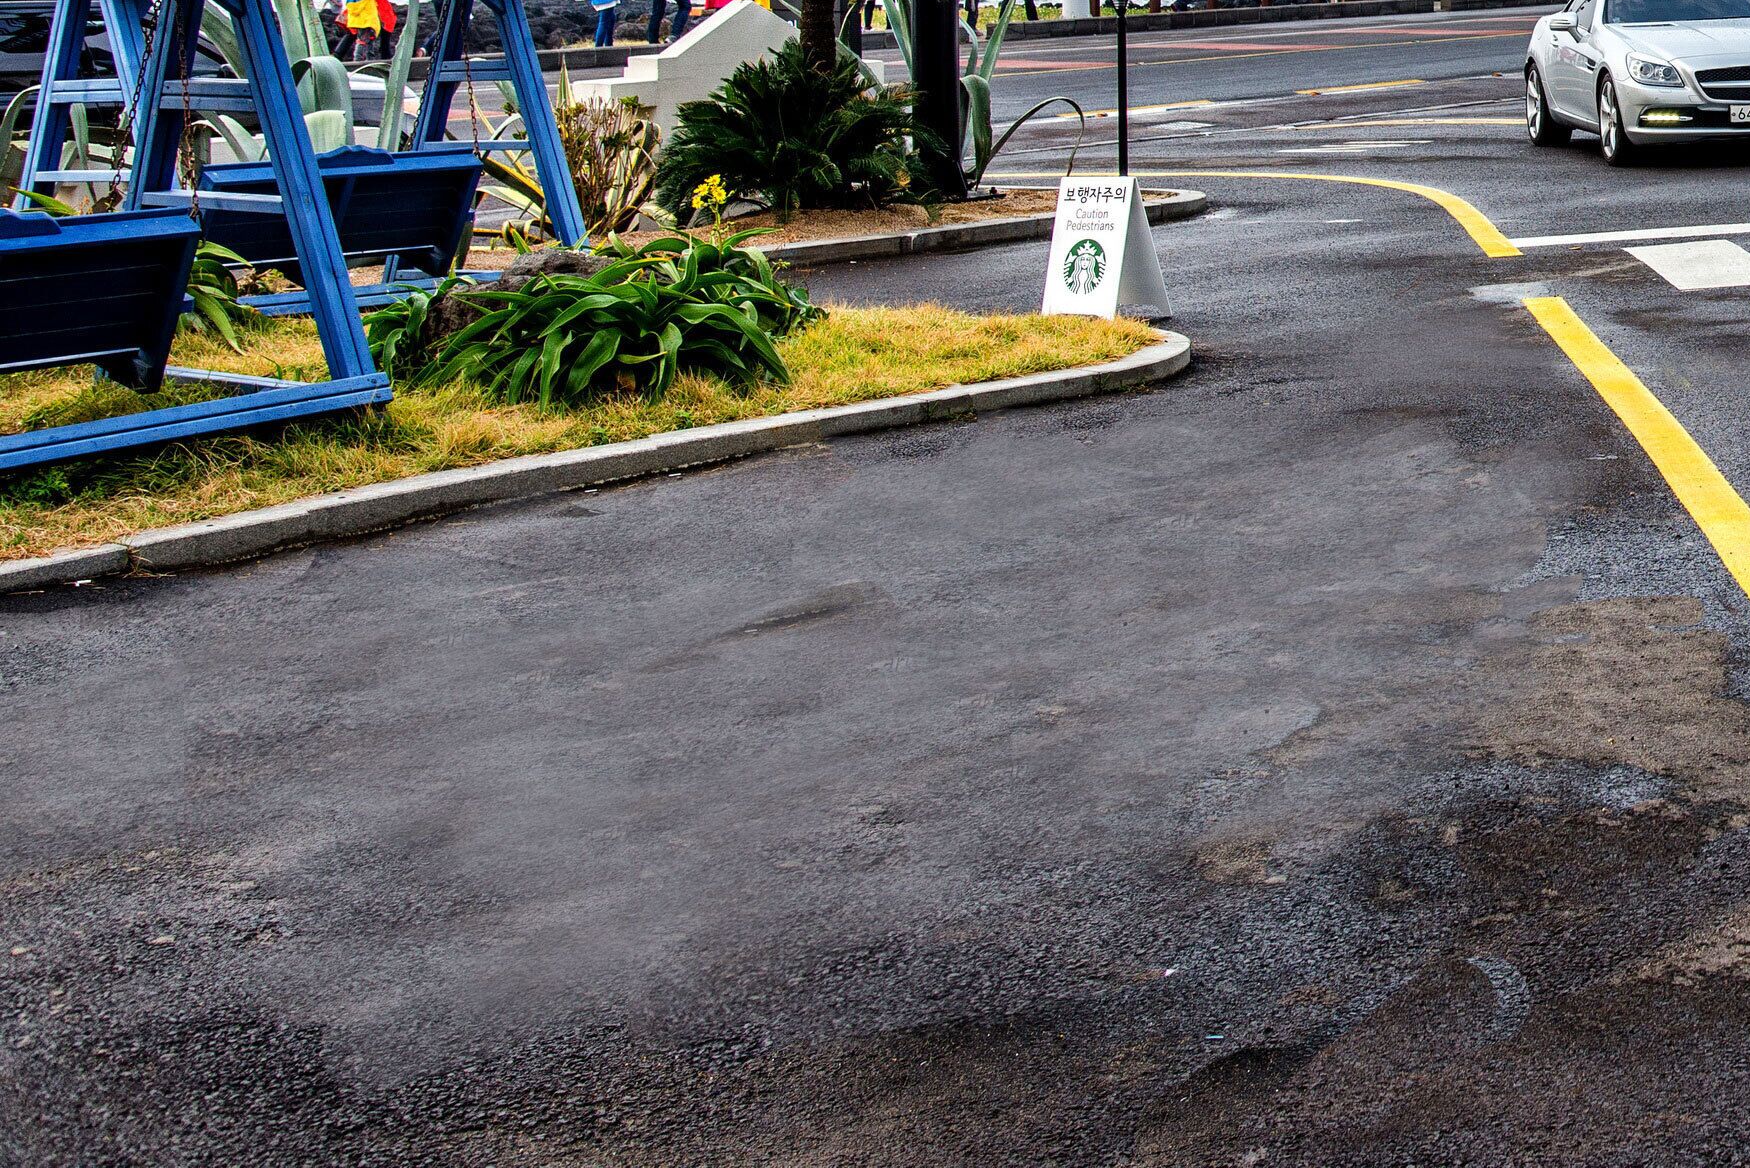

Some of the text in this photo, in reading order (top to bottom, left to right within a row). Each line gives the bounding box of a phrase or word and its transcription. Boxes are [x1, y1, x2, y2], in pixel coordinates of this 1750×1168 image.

[1063, 186, 1127, 204] 보행자주의
[1075, 207, 1109, 219] Caution
[1066, 219, 1115, 232] Pedestrians
